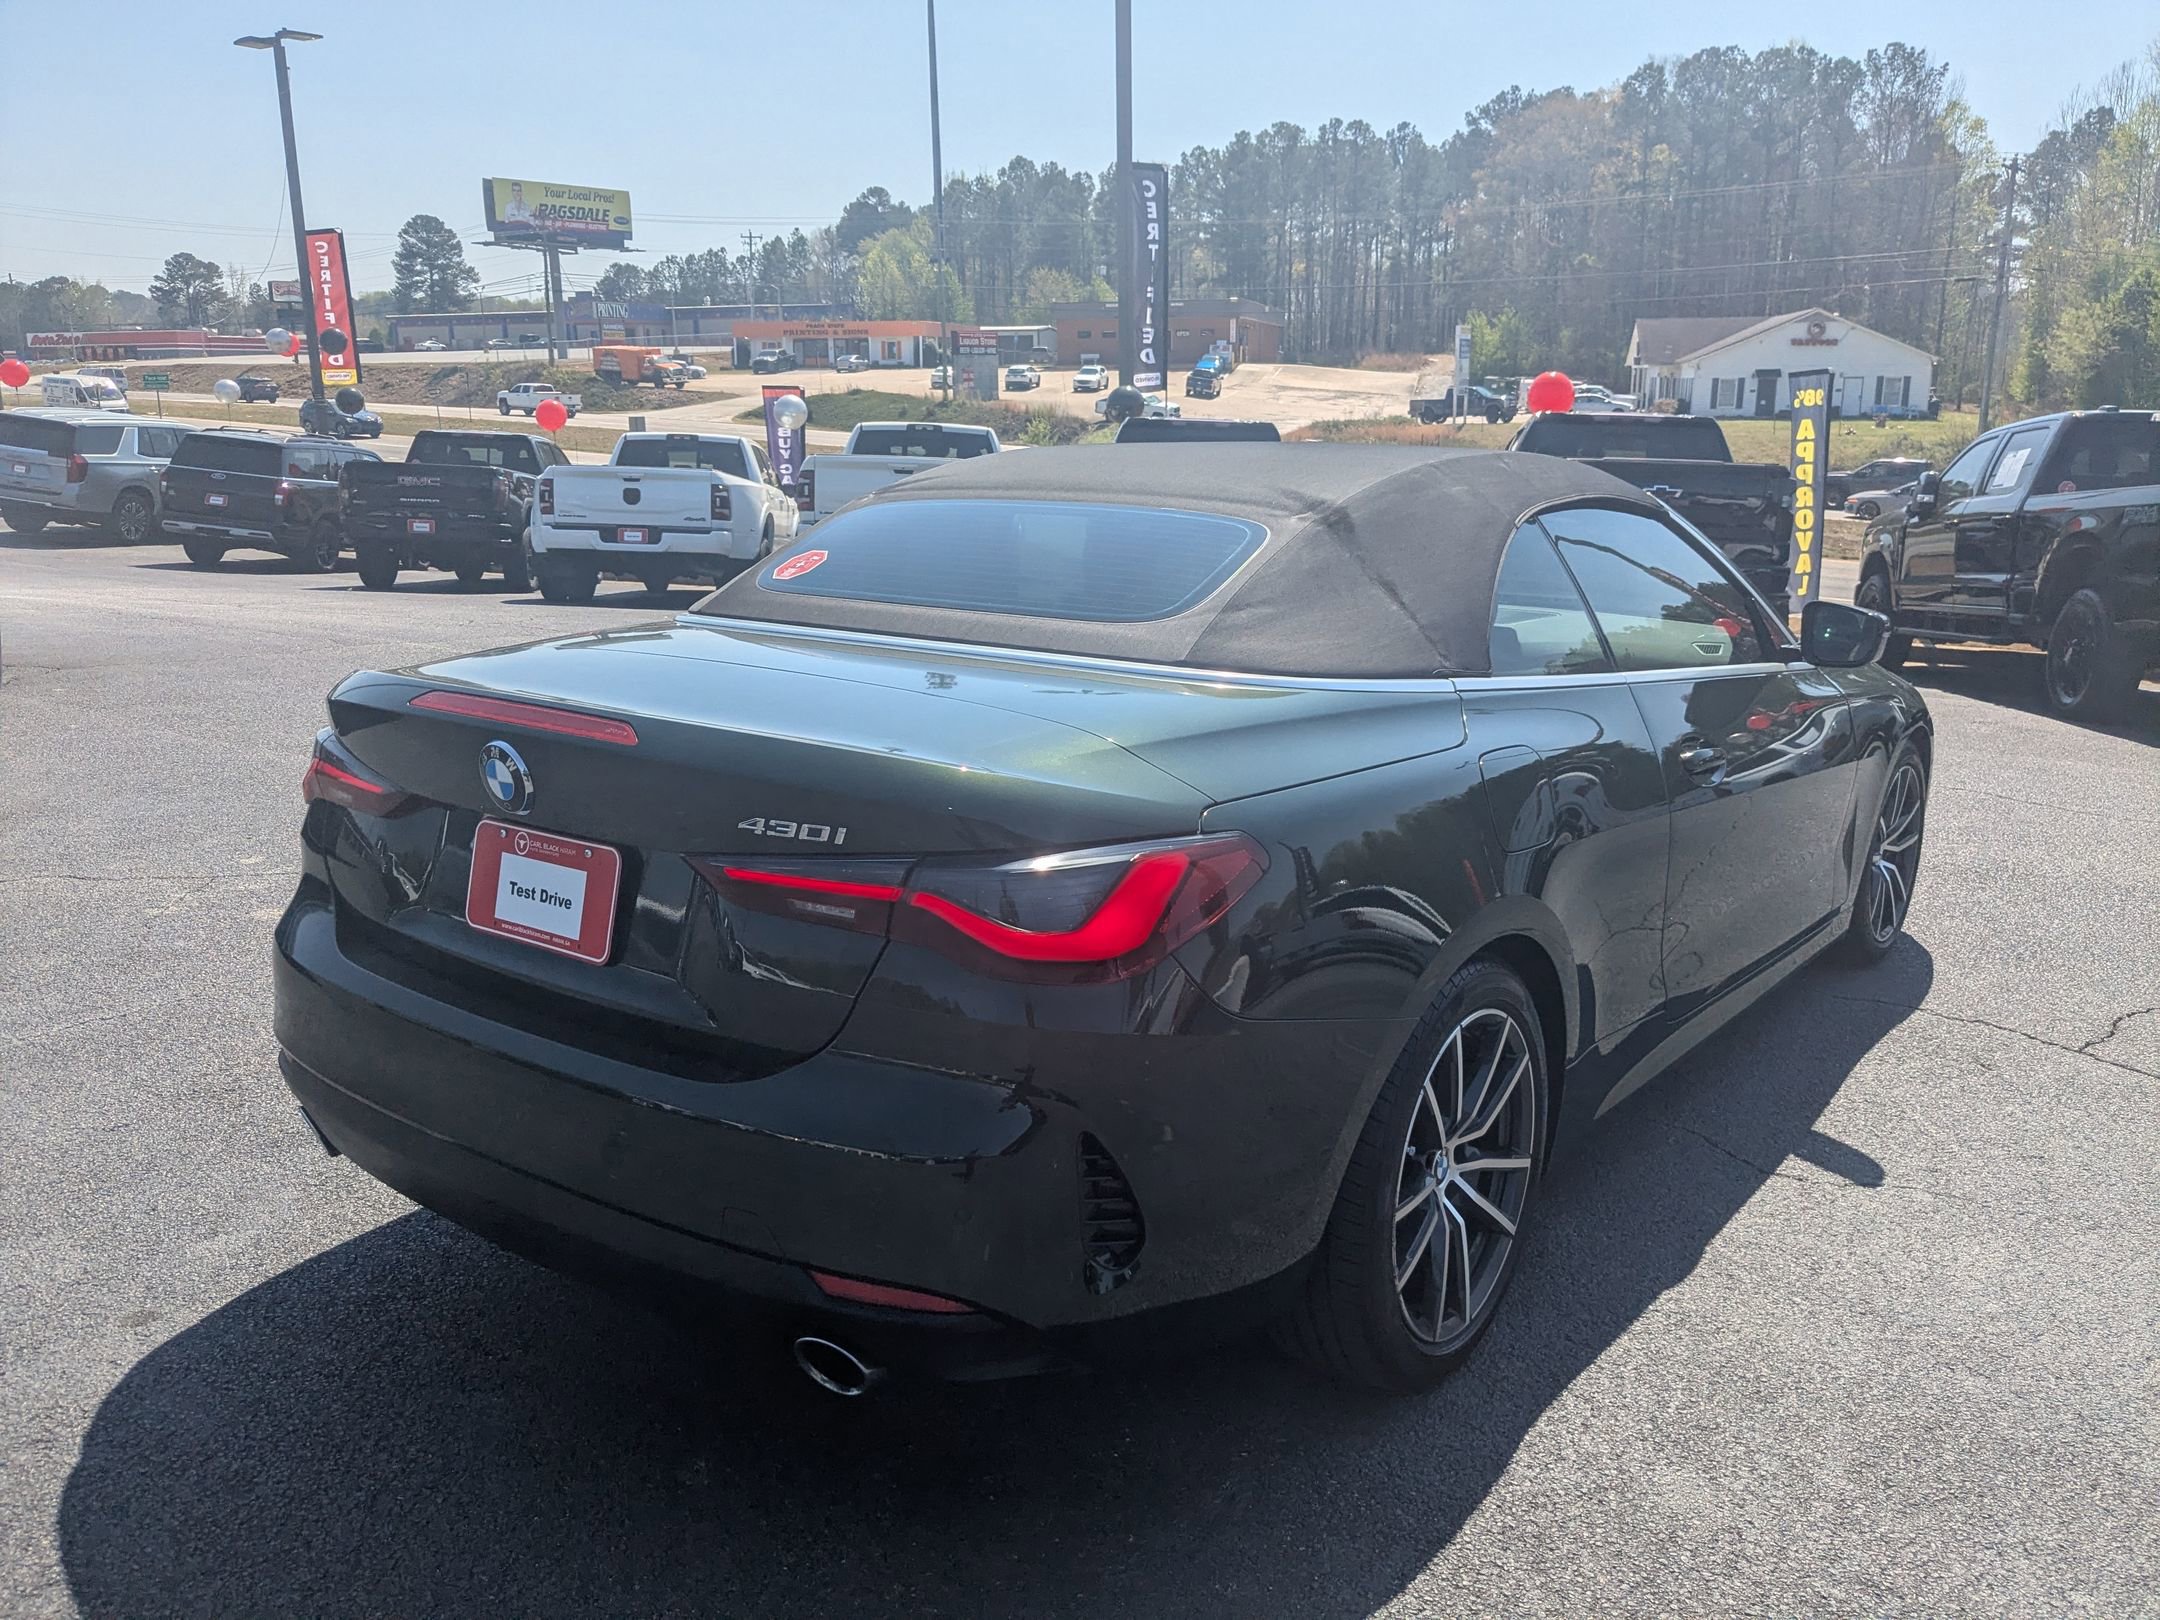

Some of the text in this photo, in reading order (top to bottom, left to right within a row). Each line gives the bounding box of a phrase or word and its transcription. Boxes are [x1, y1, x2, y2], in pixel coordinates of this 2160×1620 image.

[544, 186, 615, 204] Your Local Pros!
[539, 202, 610, 223] RAGSDALE
[597, 303, 629, 319] PRINTING
[398, 476, 440, 486] GMC
[530, 840, 543, 849] CARL
[543, 842, 560, 852] BLACK
[560, 847, 577, 857] HIRAM
[509, 880, 573, 910] Test Drive
